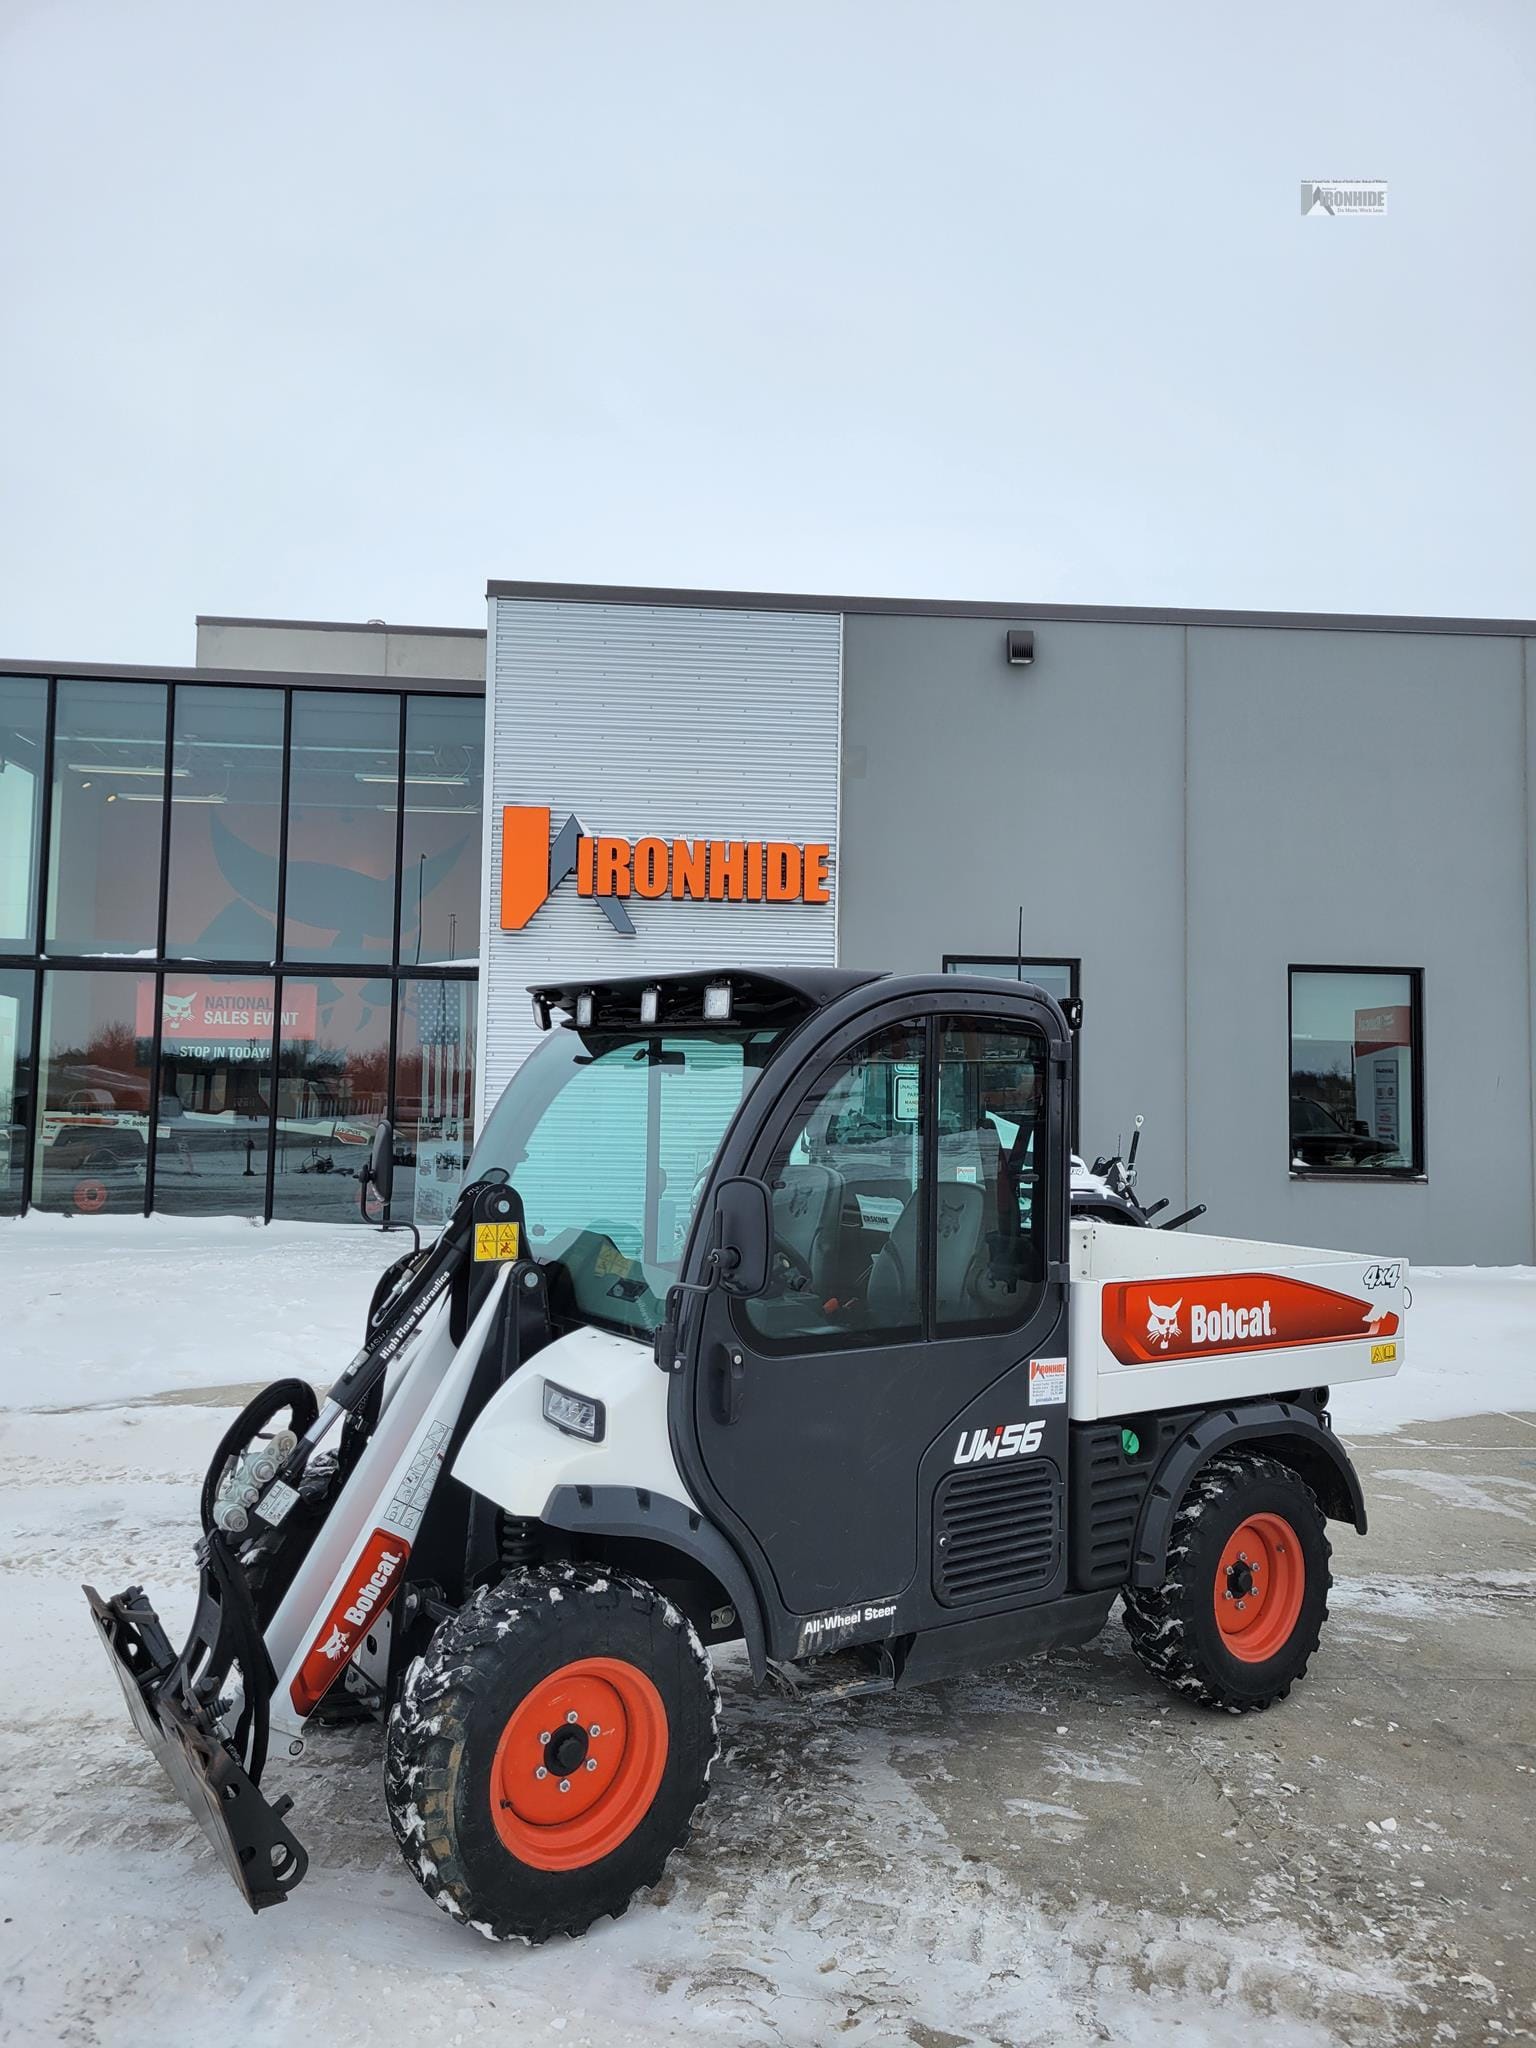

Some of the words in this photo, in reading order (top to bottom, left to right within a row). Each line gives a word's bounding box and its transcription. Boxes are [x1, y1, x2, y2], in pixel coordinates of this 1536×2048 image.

[577, 836, 830, 904] IRONHIDE
[204, 995, 273, 1010] NATIONAL
[203, 1010, 249, 1025] SALES
[253, 1012, 299, 1026] EVNT
[179, 1046, 210, 1057] STOP
[213, 1046, 227, 1058] IN
[229, 1047, 271, 1059] TODAY!
[1363, 1264, 1400, 1290] 4x4
[379, 1337, 400, 1360] High
[395, 1315, 416, 1339] Flow
[413, 1270, 451, 1316] Hydraulics
[1191, 1300, 1271, 1344] Bobcat
[343, 1551, 401, 1627] Bobcat
[804, 1610, 861, 1635] All-Wheel
[864, 1605, 897, 1621] Steer
